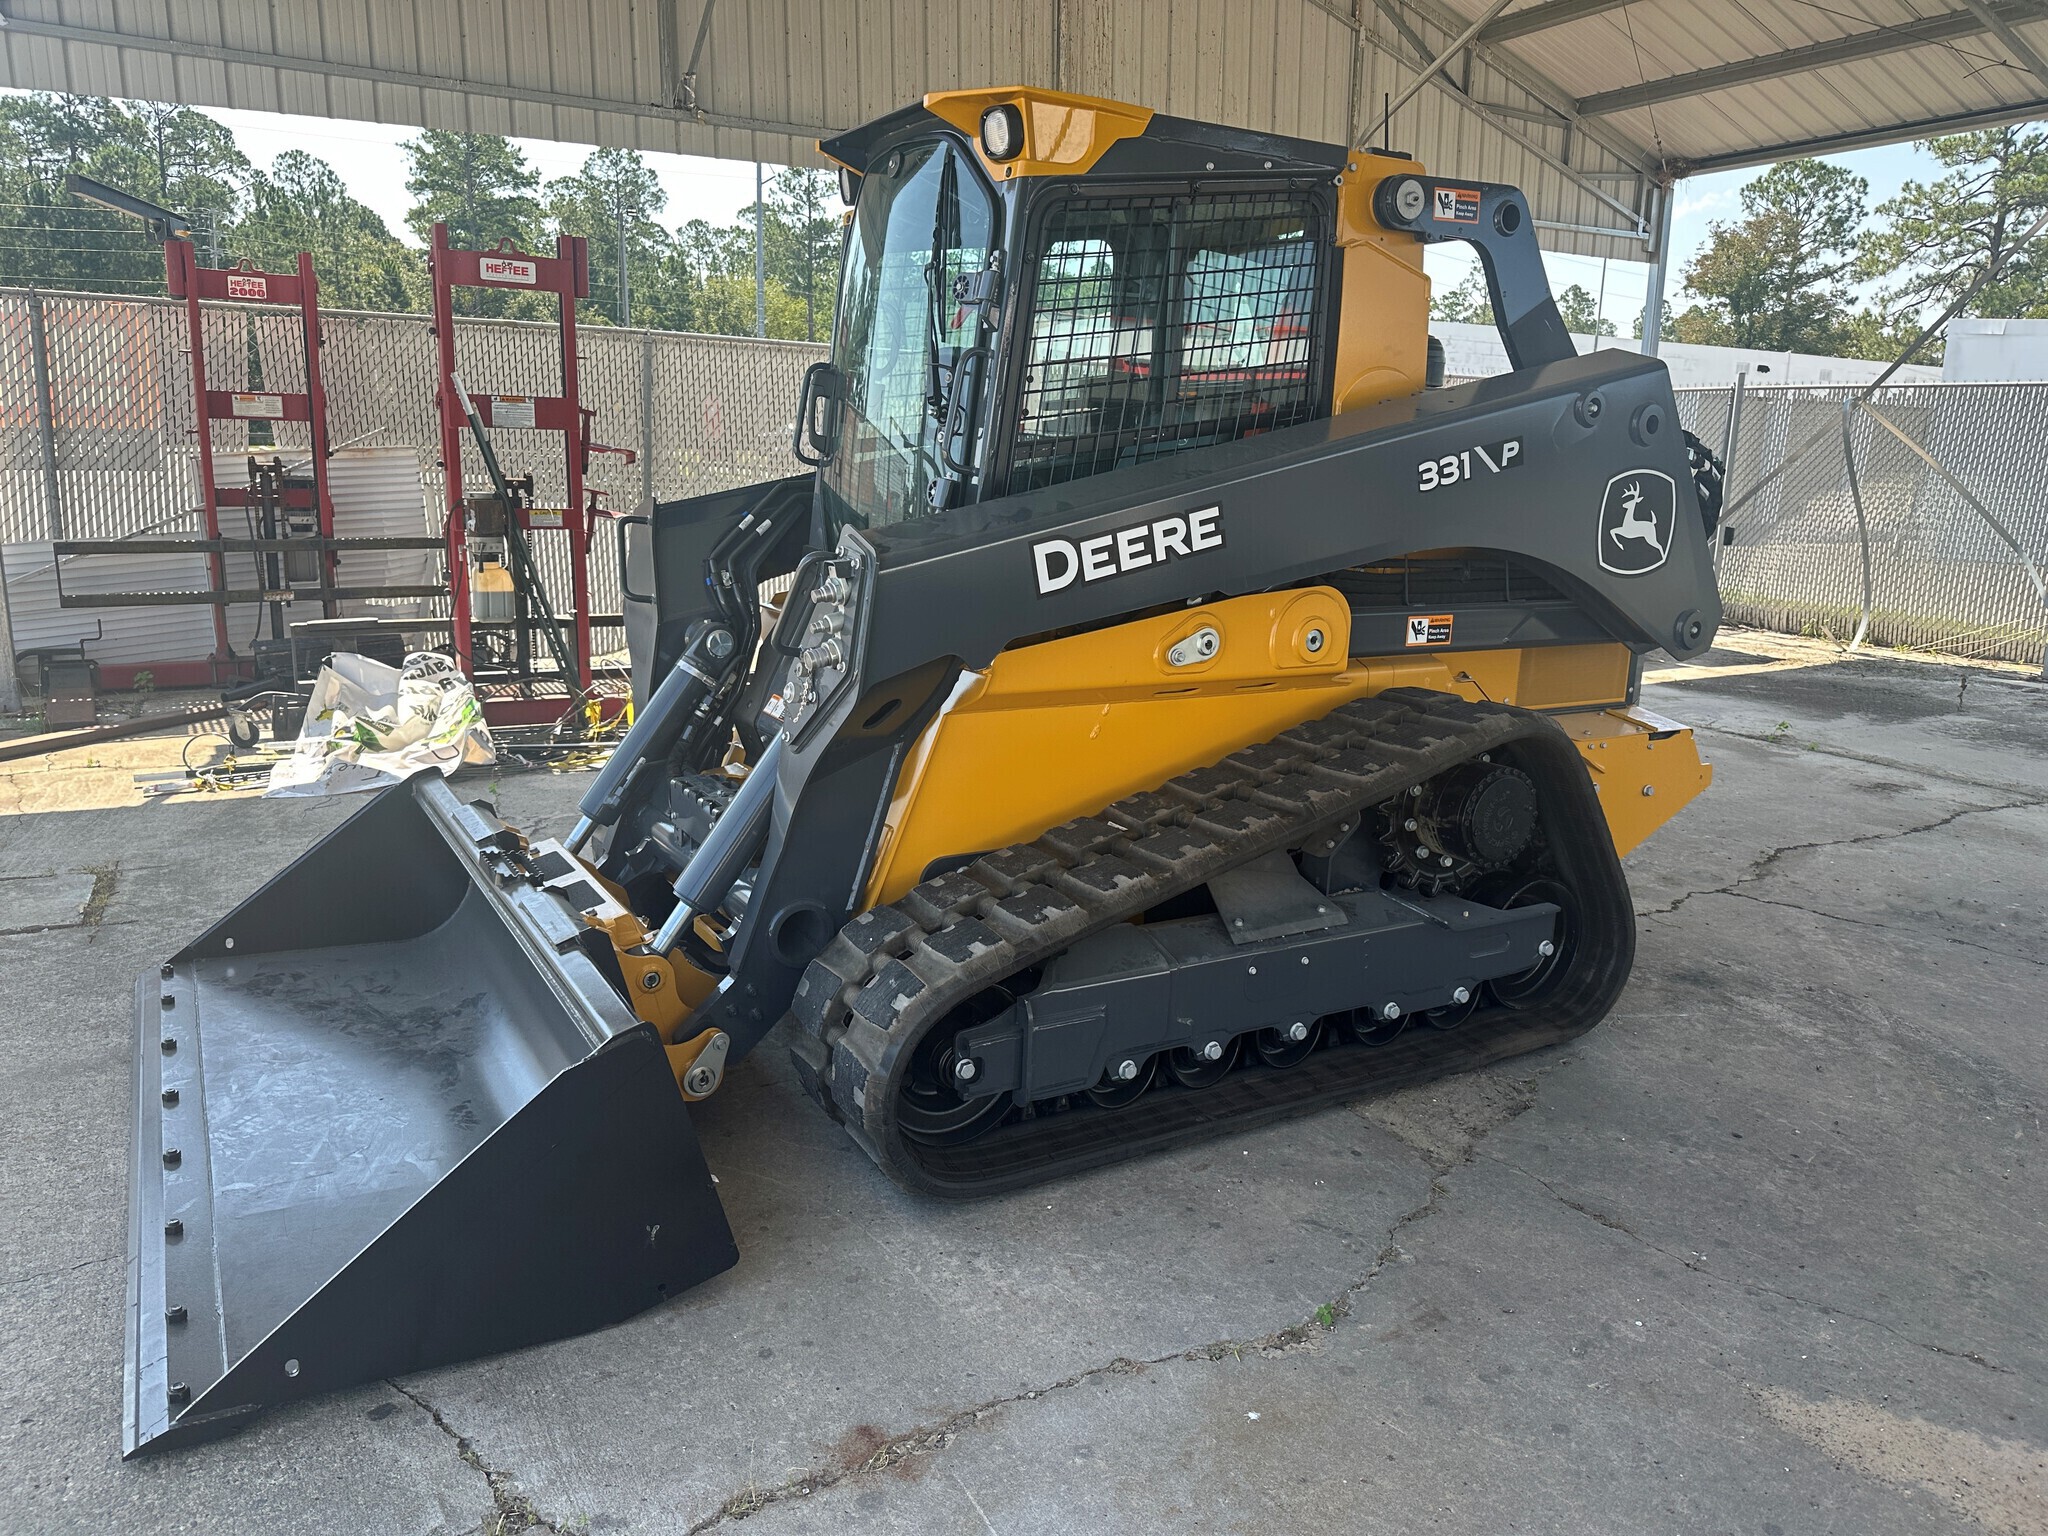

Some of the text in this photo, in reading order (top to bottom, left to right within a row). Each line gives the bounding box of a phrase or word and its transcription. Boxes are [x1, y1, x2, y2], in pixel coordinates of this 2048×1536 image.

[486, 263, 529, 276] HEFTEE
[230, 279, 264, 289] HEFTEE
[230, 287, 266, 297] 2000
[1033, 506, 1223, 594] DEERE
